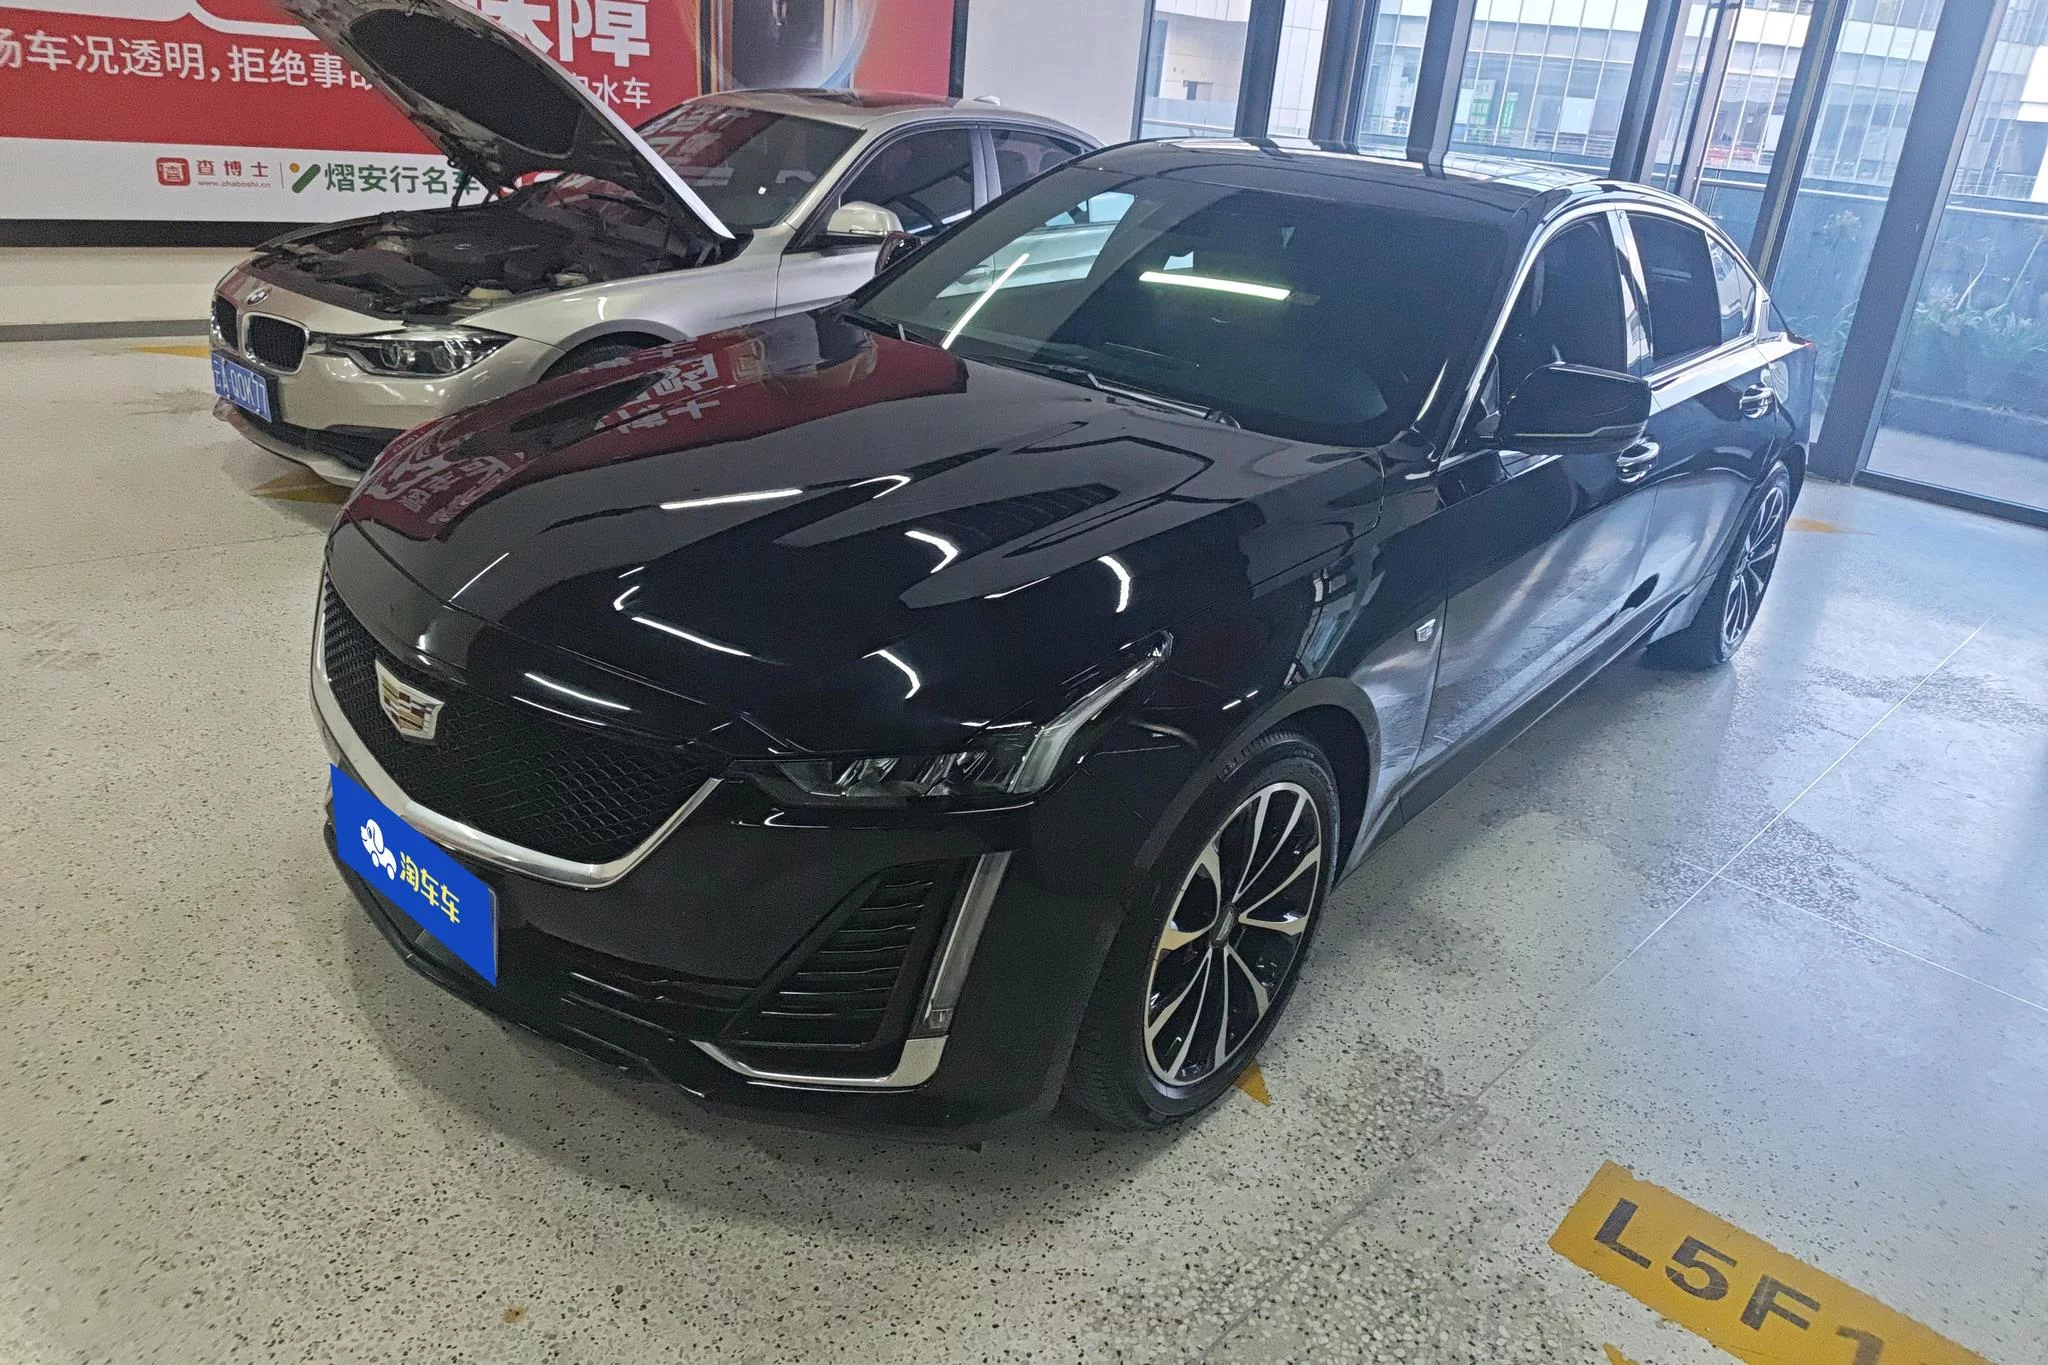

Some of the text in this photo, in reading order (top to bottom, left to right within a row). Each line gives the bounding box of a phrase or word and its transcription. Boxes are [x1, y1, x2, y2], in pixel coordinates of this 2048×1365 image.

[196, 159, 269, 178] 查博士
[198, 180, 272, 189] www.chaboshi.cn
[324, 162, 480, 195] 熠安行名车
